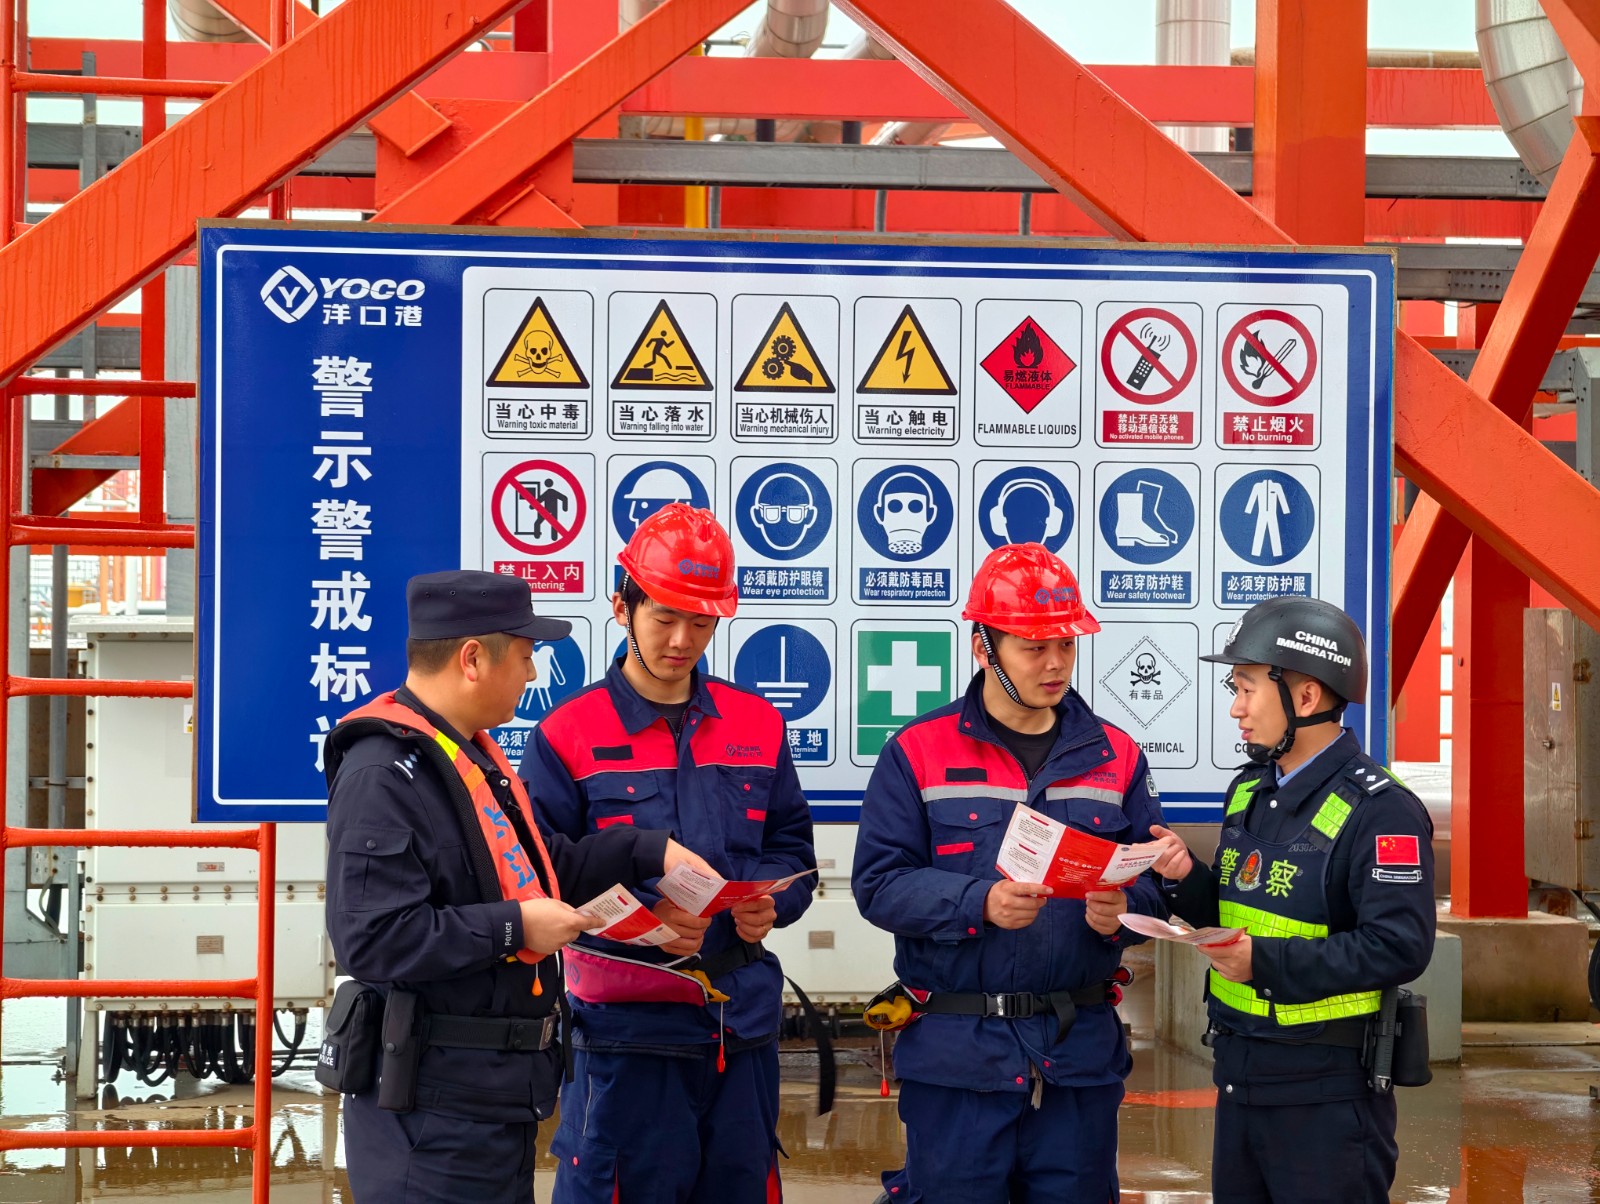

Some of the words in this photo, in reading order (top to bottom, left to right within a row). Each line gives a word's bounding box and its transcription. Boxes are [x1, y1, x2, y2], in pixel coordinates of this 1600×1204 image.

[320, 277, 425, 301] YOCO
[323, 303, 422, 327] 洋口港
[1003, 370, 1053, 382] 易燃液体
[496, 403, 580, 421] 当心中毒
[619, 405, 704, 422] 当心落水
[741, 407, 828, 425] 当心机械伤人
[864, 409, 948, 426] 当心触电
[1118, 414, 1178, 424] 禁止开启无线
[497, 420, 528, 430] Warning
[530, 420, 547, 429] toxic
[549, 421, 578, 430] material
[620, 422, 647, 432] Warning
[649, 422, 670, 433] falling
[671, 423, 684, 431] into
[685, 424, 703, 432] water
[740, 424, 768, 434] Warning
[770, 424, 809, 434] mechanical
[810, 425, 829, 435] injury
[868, 426, 902, 436] Warning
[905, 426, 945, 437] electricity
[978, 423, 1036, 435] FLAMMABLE
[1038, 424, 1077, 436] LIQUIDS
[1118, 424, 1178, 434] 移动通信设备
[1232, 415, 1304, 433] 禁止烟火
[1242, 433, 1255, 442] No
[1257, 433, 1293, 443] burning
[498, 564, 580, 580] 禁止入内
[743, 570, 824, 587] 必须戴防护眼镜
[865, 572, 944, 588] 必须戴防毒面具
[1109, 574, 1184, 591] 必须穿防护鞋
[1227, 575, 1305, 591] 必须穿防护服
[742, 587, 764, 596] Wear
[766, 588, 781, 596] eye
[782, 588, 824, 597] protection
[864, 588, 881, 596] Wear
[883, 588, 914, 598] respiratory
[915, 589, 946, 598] protection
[1107, 590, 1126, 599] Wear
[1128, 591, 1151, 601] safety
[1152, 591, 1186, 600] footwear
[1227, 592, 1244, 600] Wear
[1295, 631, 1338, 652] CHINA
[1276, 637, 1351, 667] IMMIGRATION
[1128, 689, 1163, 700] 有毒品
[504, 921, 513, 946] POLICE
